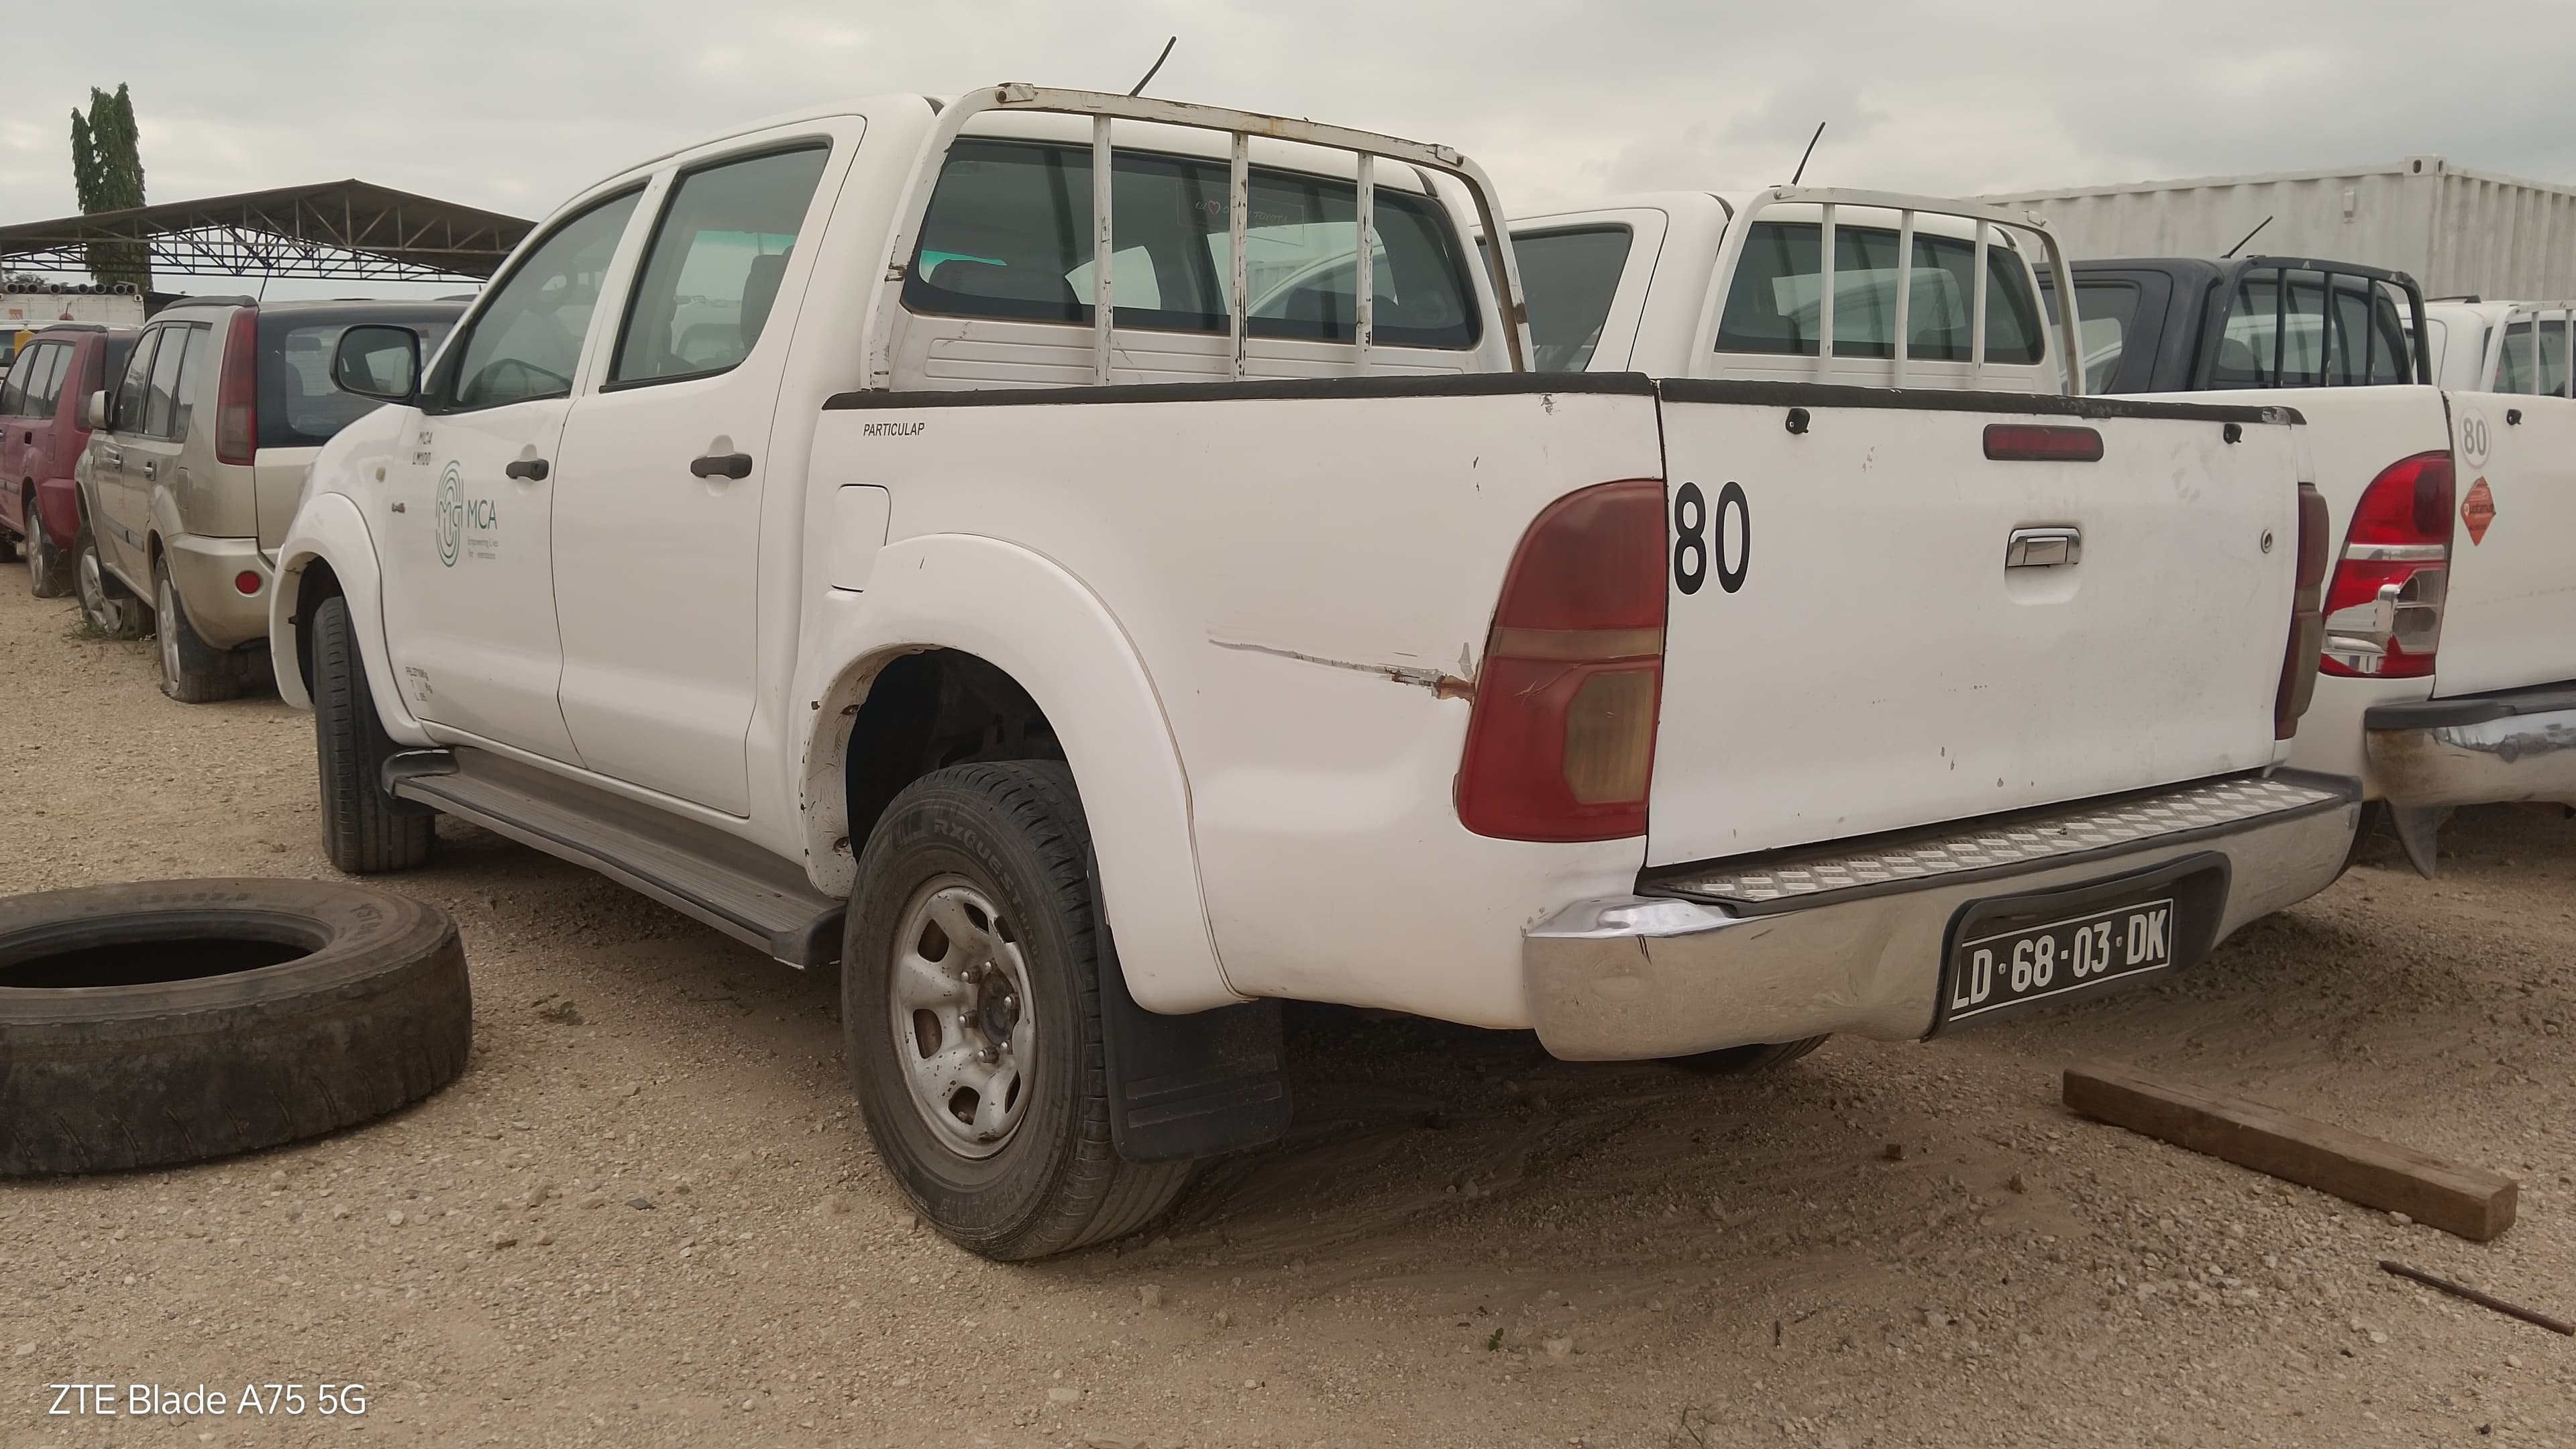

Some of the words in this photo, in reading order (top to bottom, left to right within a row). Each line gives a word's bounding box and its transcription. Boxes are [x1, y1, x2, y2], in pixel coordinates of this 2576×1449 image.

[1253, 211, 1288, 223] TOYOTA
[417, 431, 433, 445] MCA
[2463, 417, 2487, 455] 80
[467, 499, 498, 530] MCA
[1674, 482, 1750, 595] 80
